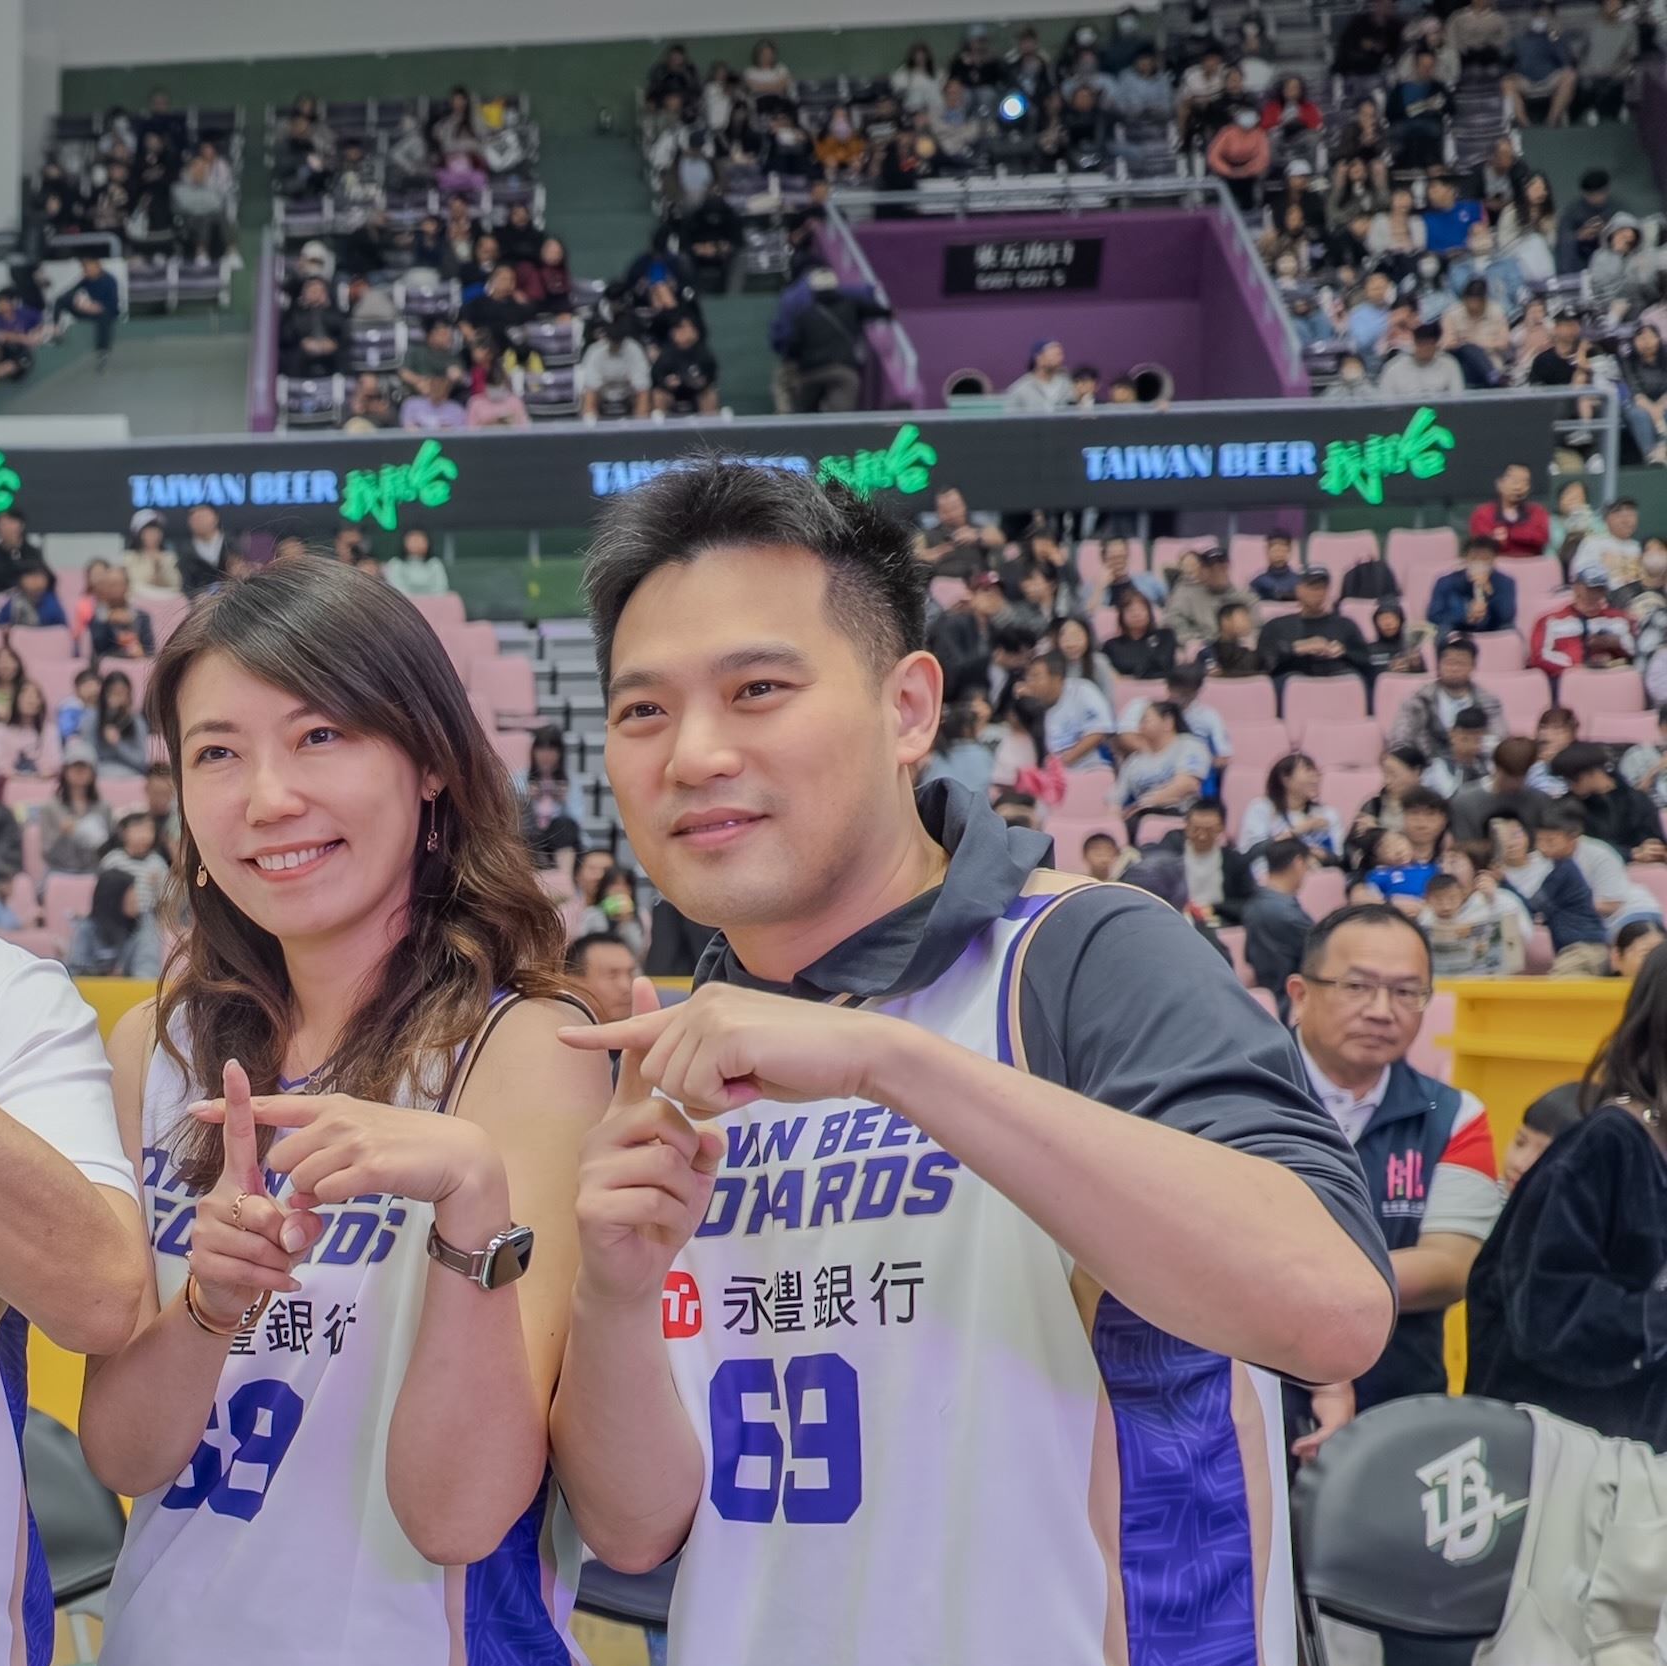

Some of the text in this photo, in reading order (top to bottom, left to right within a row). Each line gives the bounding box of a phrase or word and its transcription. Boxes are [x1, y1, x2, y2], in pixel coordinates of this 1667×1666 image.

[1082, 441, 1318, 481] TAIWAN BEER
[128, 470, 338, 508] TAIWAN BEER
[814, 1105, 930, 1160] BEE
[723, 1261, 924, 1335] 永豐銀行
[709, 1353, 862, 1524] 69
